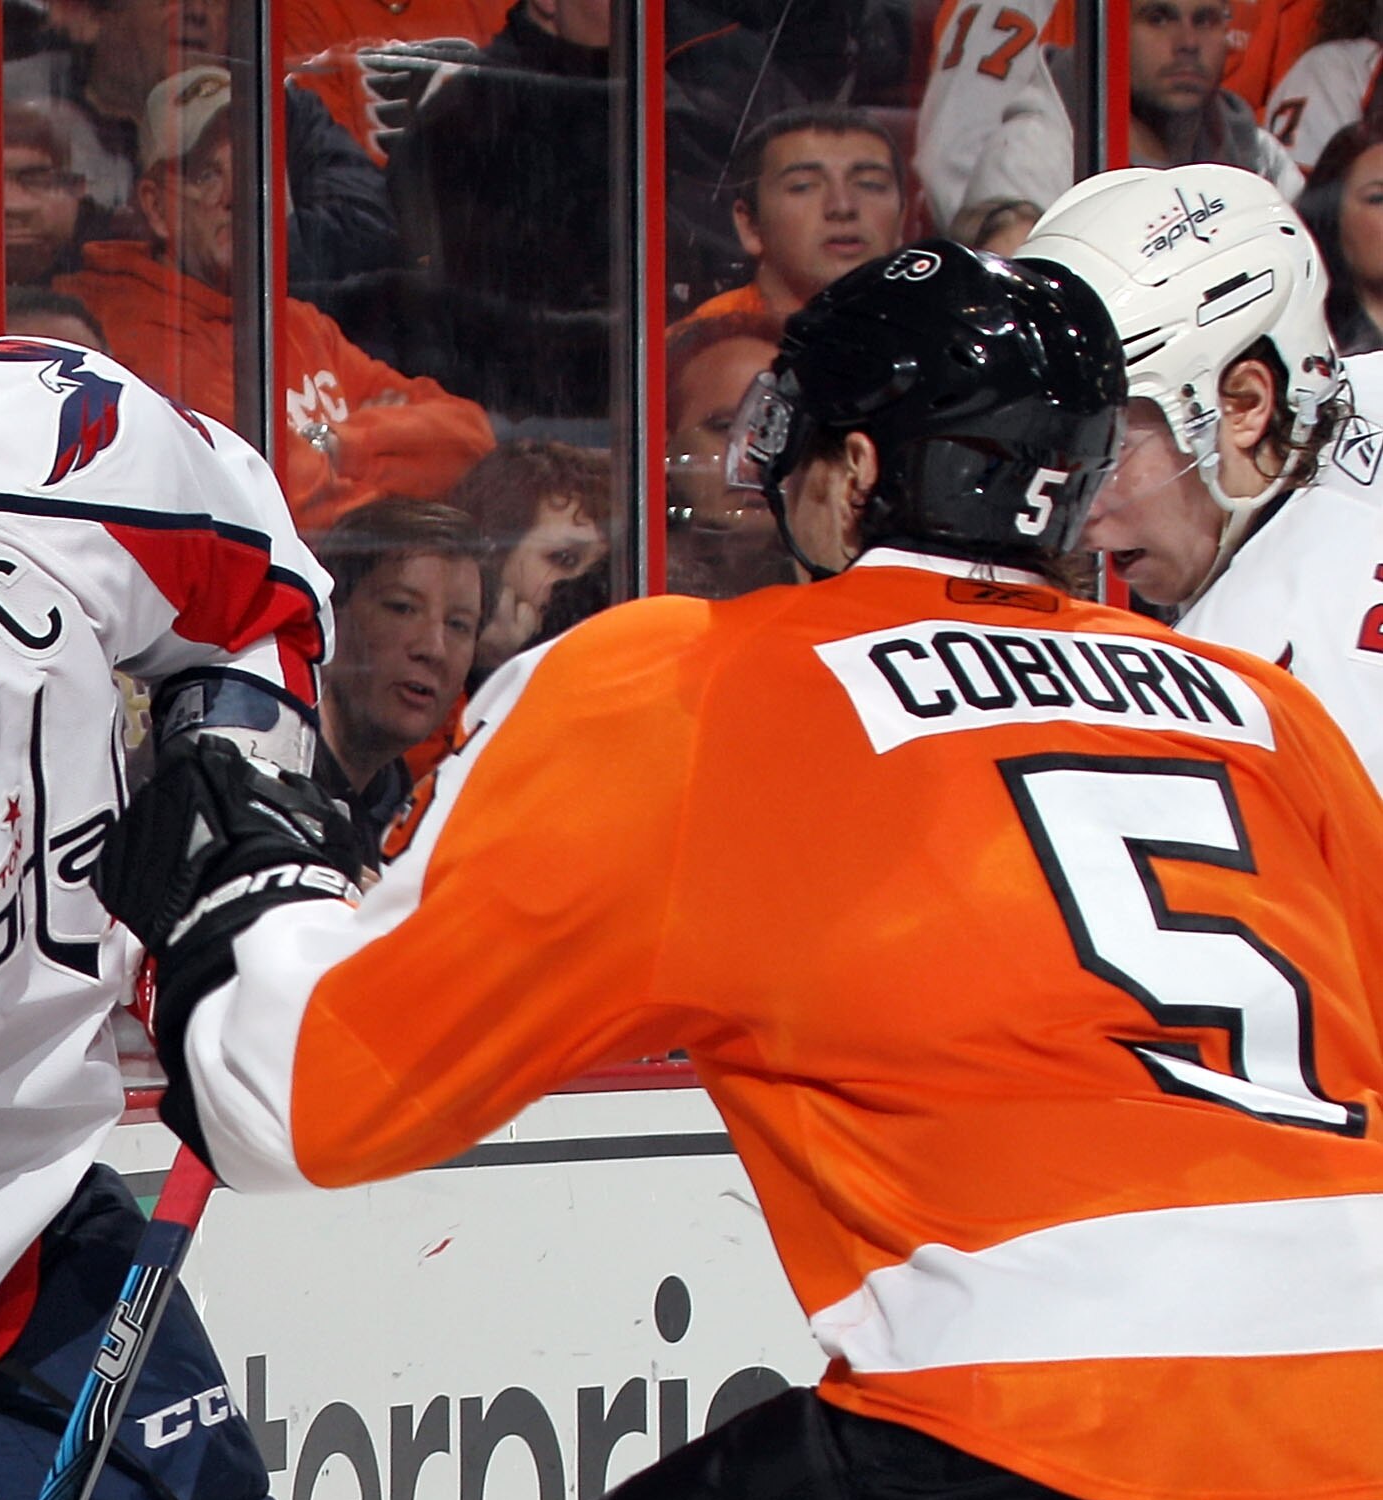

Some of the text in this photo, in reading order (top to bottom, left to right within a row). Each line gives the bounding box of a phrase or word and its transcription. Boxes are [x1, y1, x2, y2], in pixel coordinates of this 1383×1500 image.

[942, 3, 1038, 81] 17
[1016, 468, 1070, 537] 5
[868, 631, 1246, 719] COBURN
[995, 753, 1367, 1140] 5
[135, 1384, 238, 1449] CC
